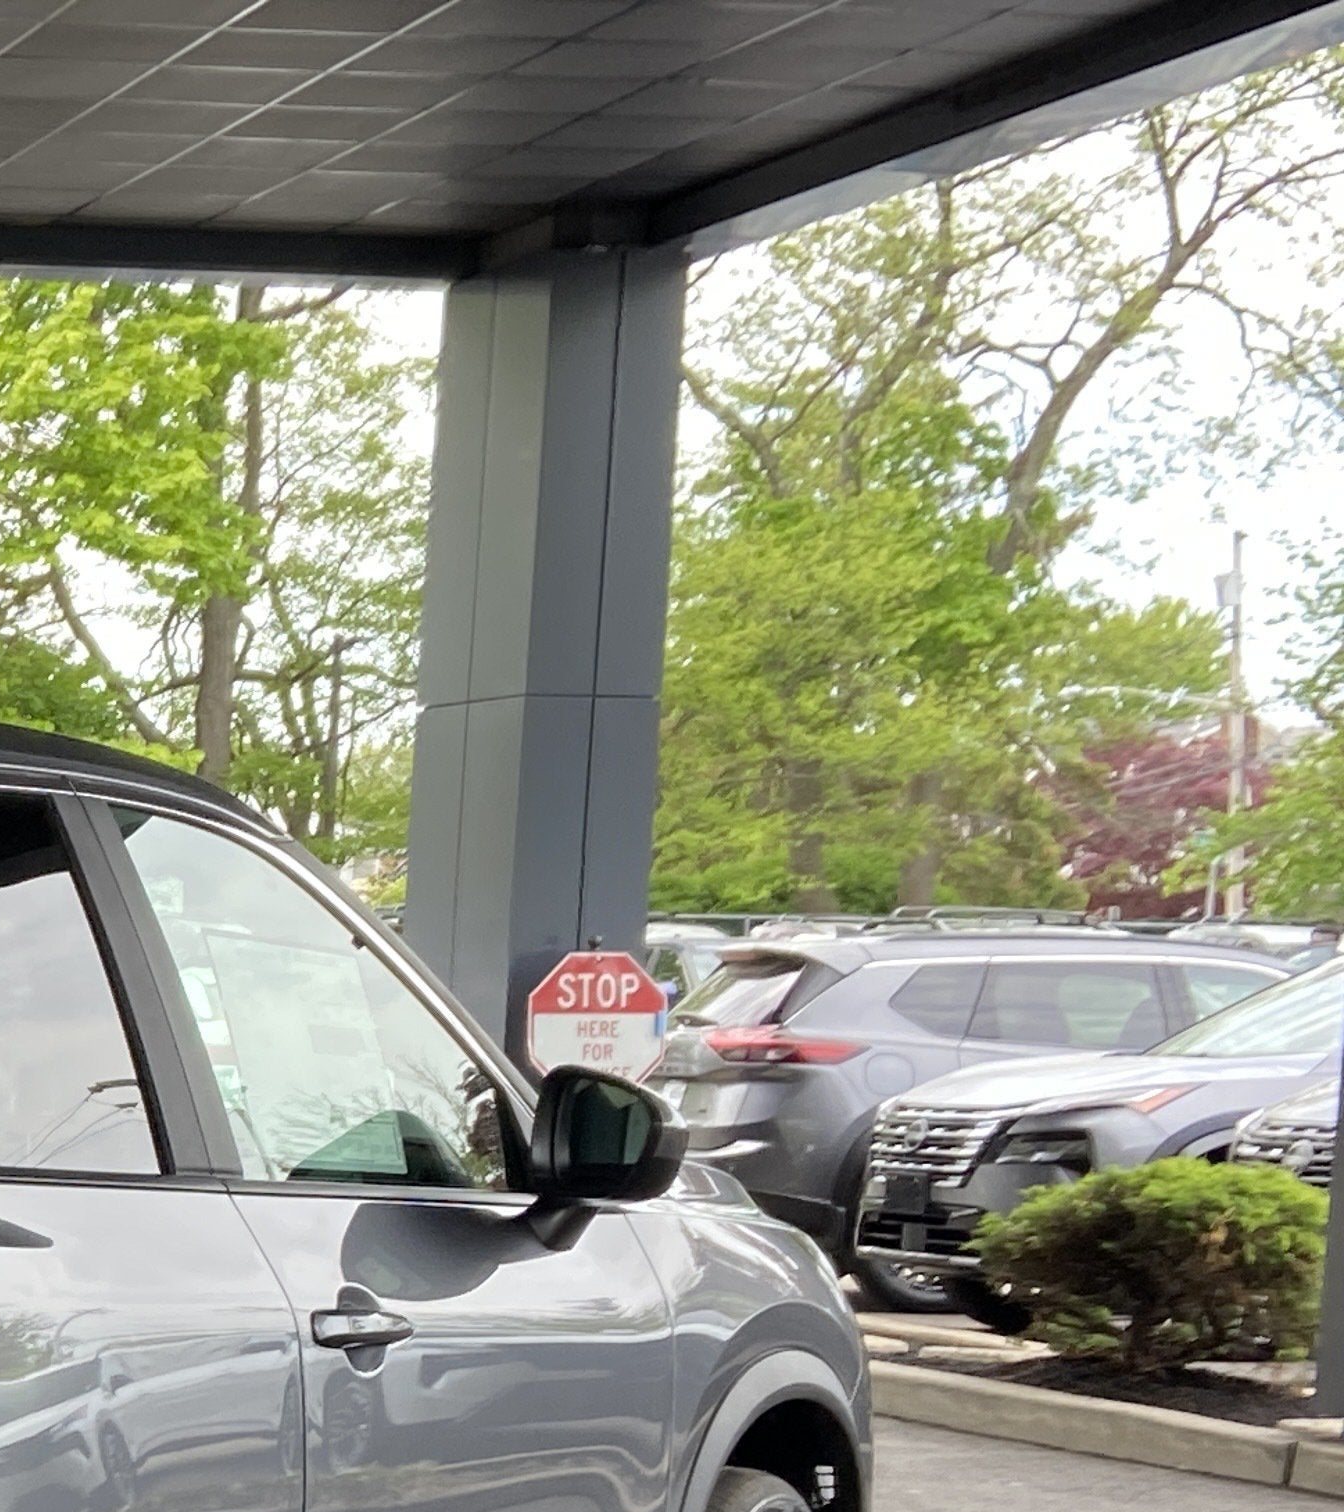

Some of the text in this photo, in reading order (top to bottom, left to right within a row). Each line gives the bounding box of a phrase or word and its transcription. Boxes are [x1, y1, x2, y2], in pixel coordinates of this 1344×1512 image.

[556, 972, 640, 1009] STOP
[576, 1020, 621, 1038] HERE
[582, 1044, 614, 1061] FOR
